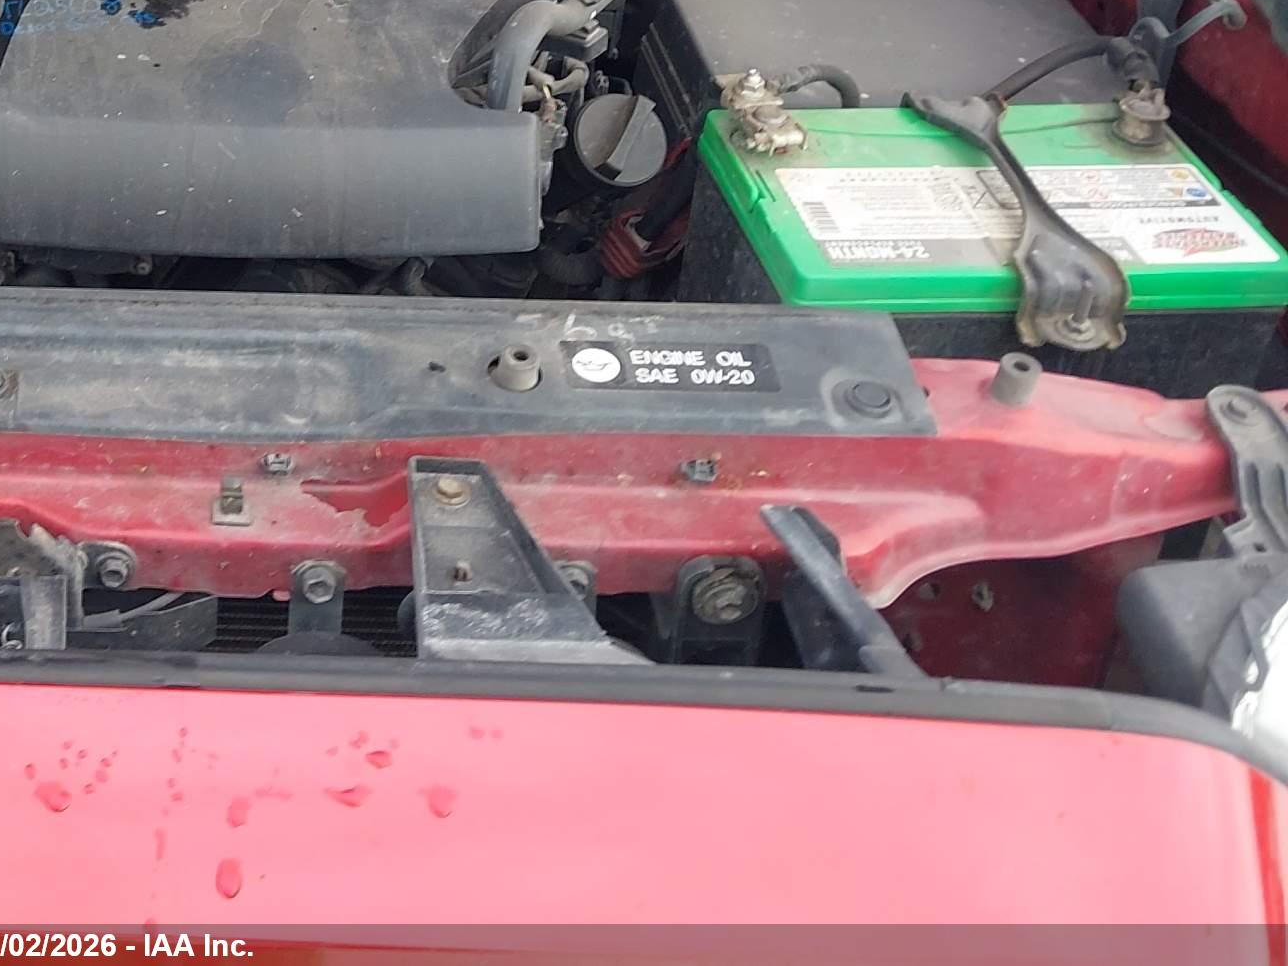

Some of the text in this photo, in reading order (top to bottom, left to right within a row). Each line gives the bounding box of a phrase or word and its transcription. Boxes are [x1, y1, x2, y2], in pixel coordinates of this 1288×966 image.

[629, 350, 753, 367] ENGINE OIL
[635, 368, 756, 385] SAE 0W-20
